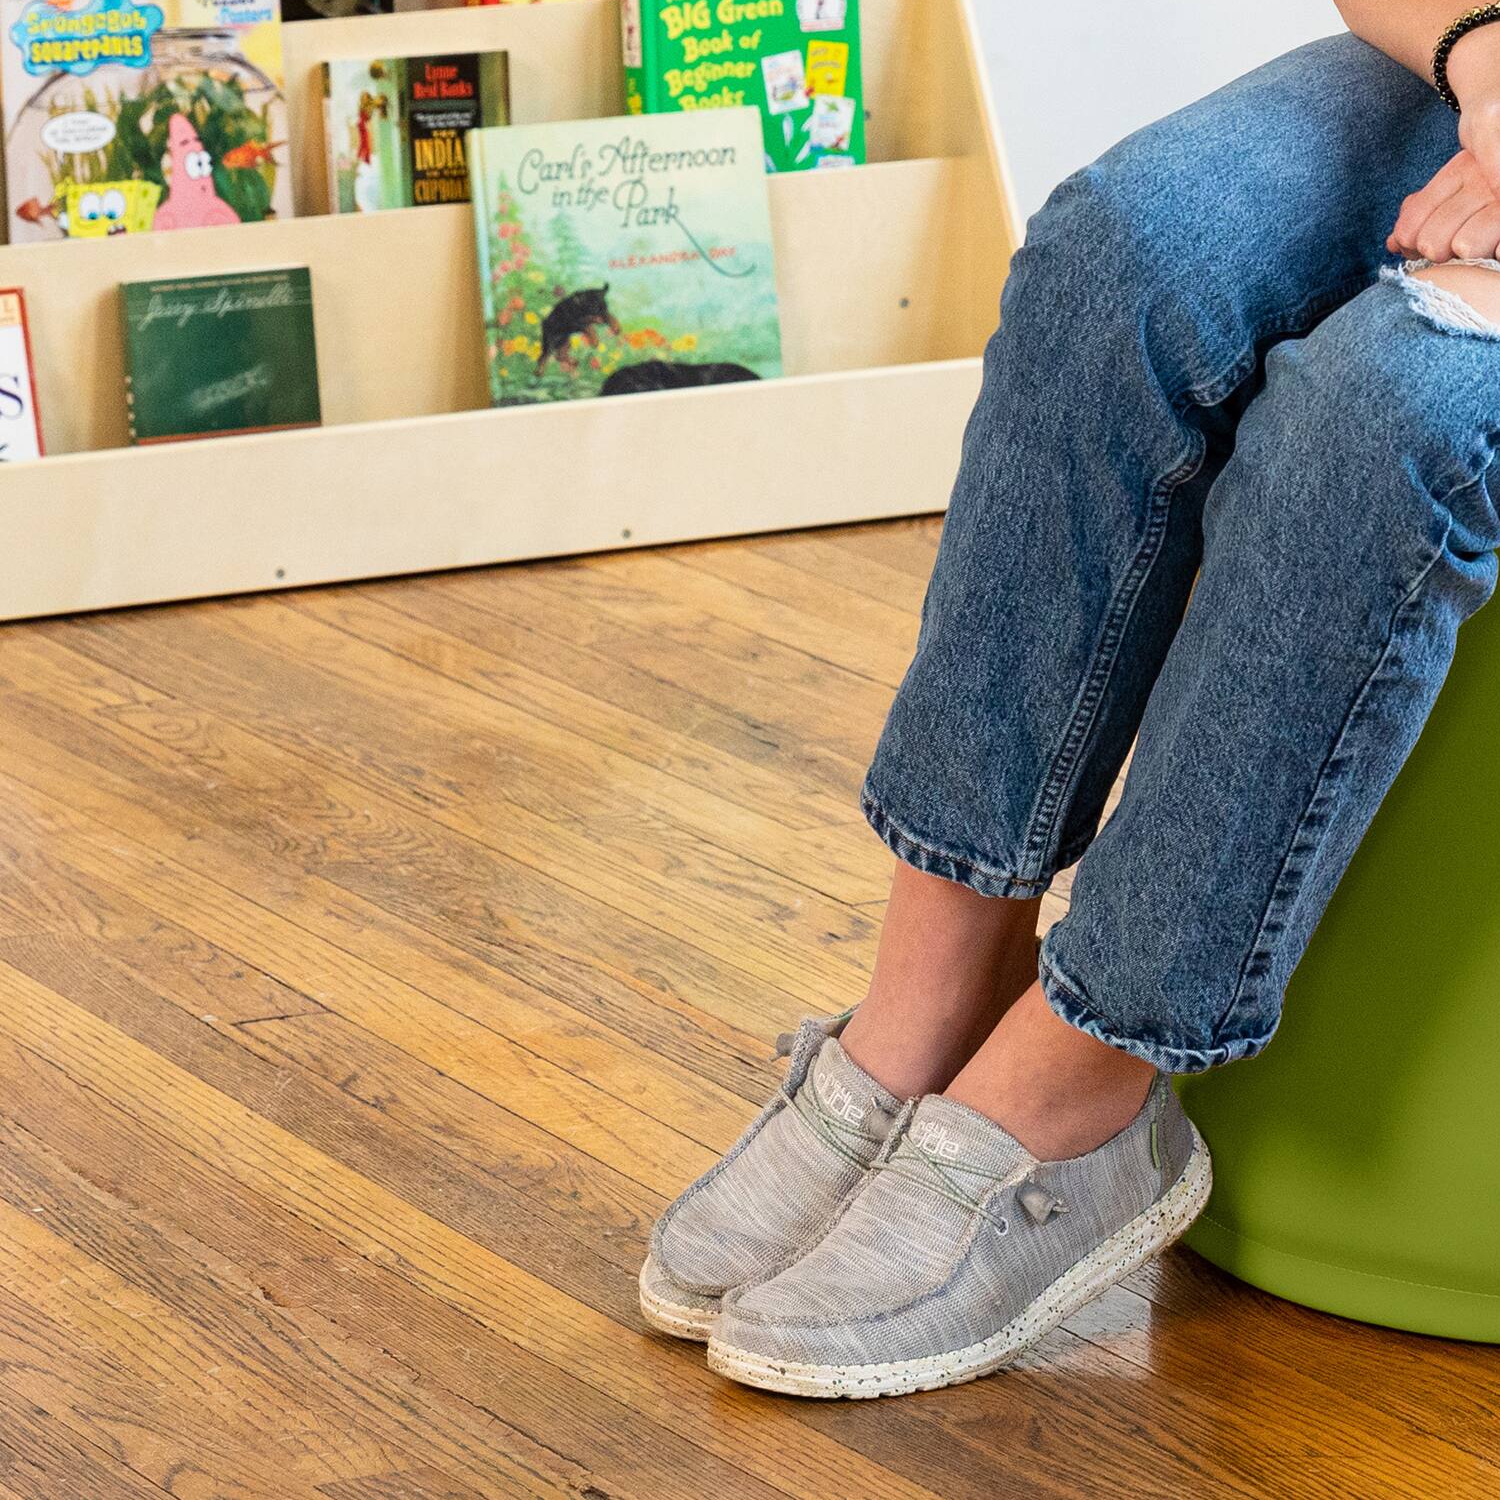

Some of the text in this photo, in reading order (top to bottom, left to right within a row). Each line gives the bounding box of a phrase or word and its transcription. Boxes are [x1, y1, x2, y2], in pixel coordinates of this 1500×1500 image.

[659, 0, 711, 40] BIG
[682, 28, 733, 63] Book
[518, 143, 592, 195] Carl's
[599, 136, 736, 177] Afternoon
[552, 178, 680, 228] in the Park
